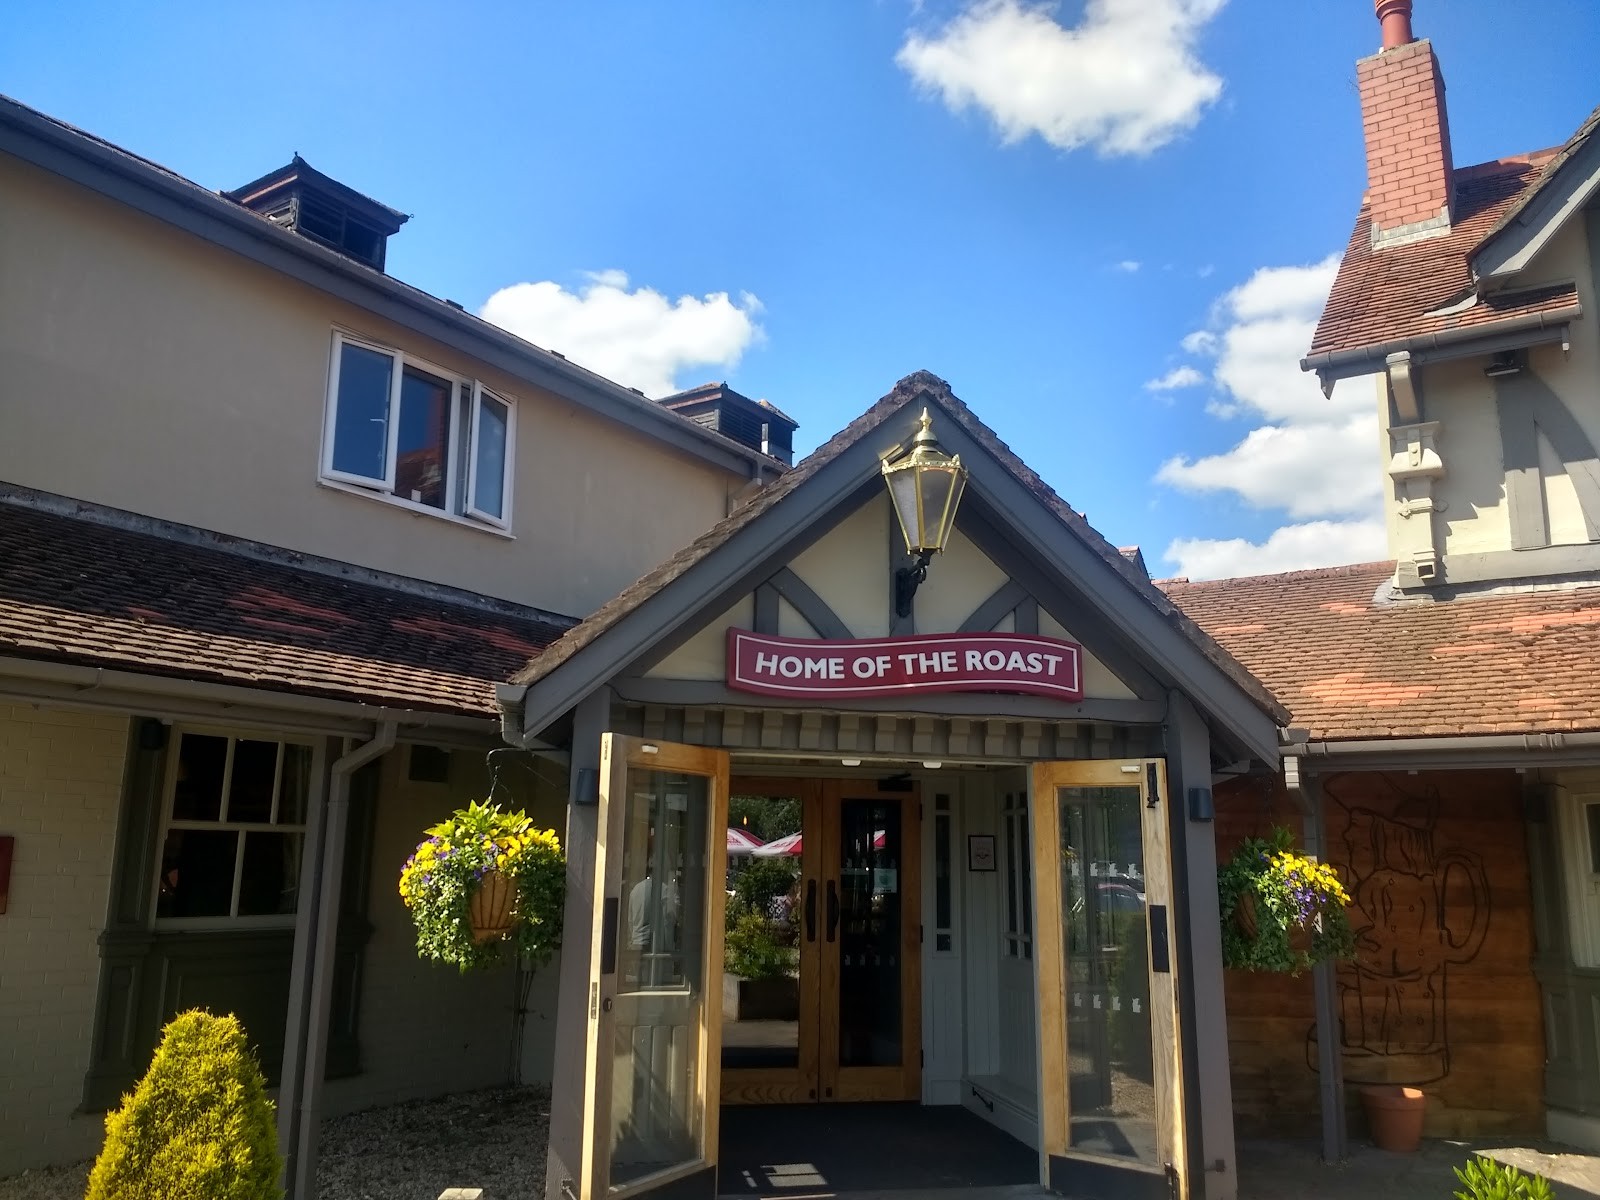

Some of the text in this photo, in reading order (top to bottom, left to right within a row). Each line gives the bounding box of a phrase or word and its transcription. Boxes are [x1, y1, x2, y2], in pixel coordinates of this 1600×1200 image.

[755, 650, 1063, 680] HOME OF THE ROAST
